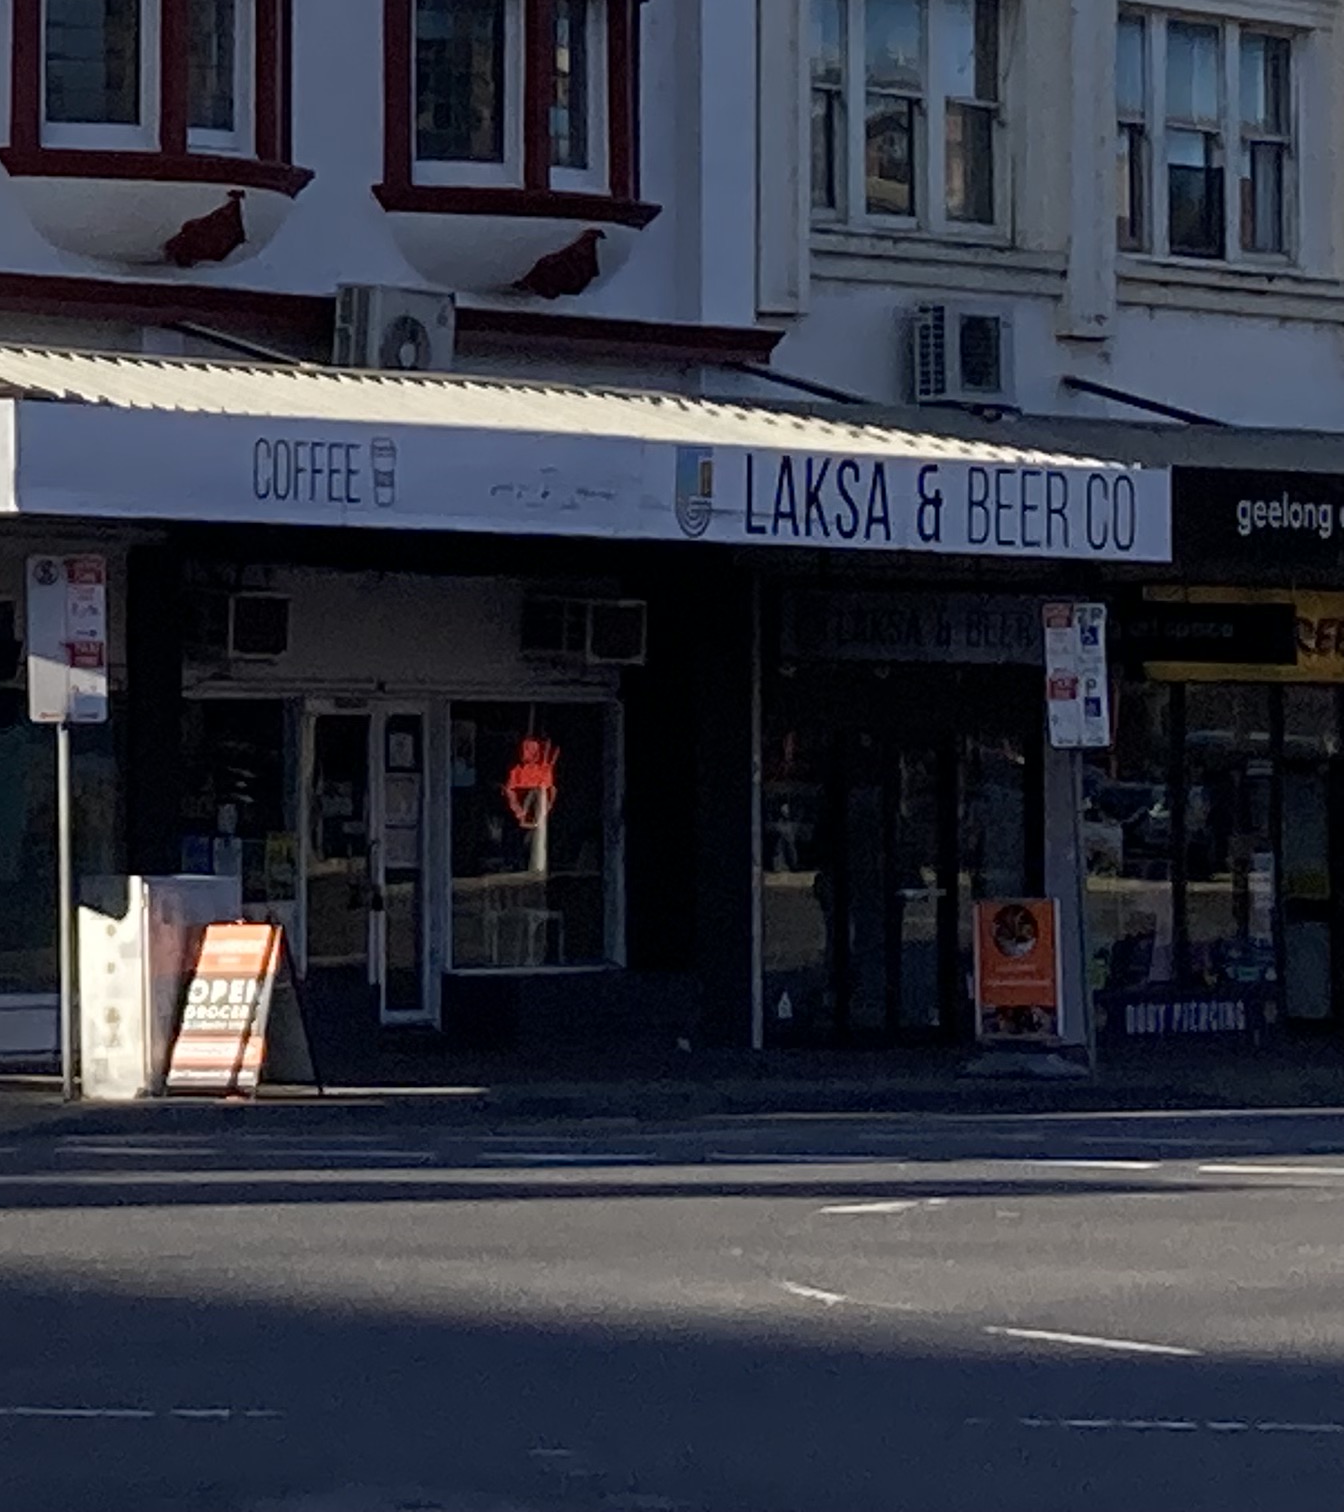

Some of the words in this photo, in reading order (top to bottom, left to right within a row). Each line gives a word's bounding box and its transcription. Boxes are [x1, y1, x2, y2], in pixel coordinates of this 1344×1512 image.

[252, 436, 362, 504] COFFEE
[745, 452, 892, 542] LAKSA
[917, 463, 944, 543] &
[967, 465, 1070, 549] BEER
[1086, 473, 1137, 551] CO
[1236, 490, 1333, 539] geelong
